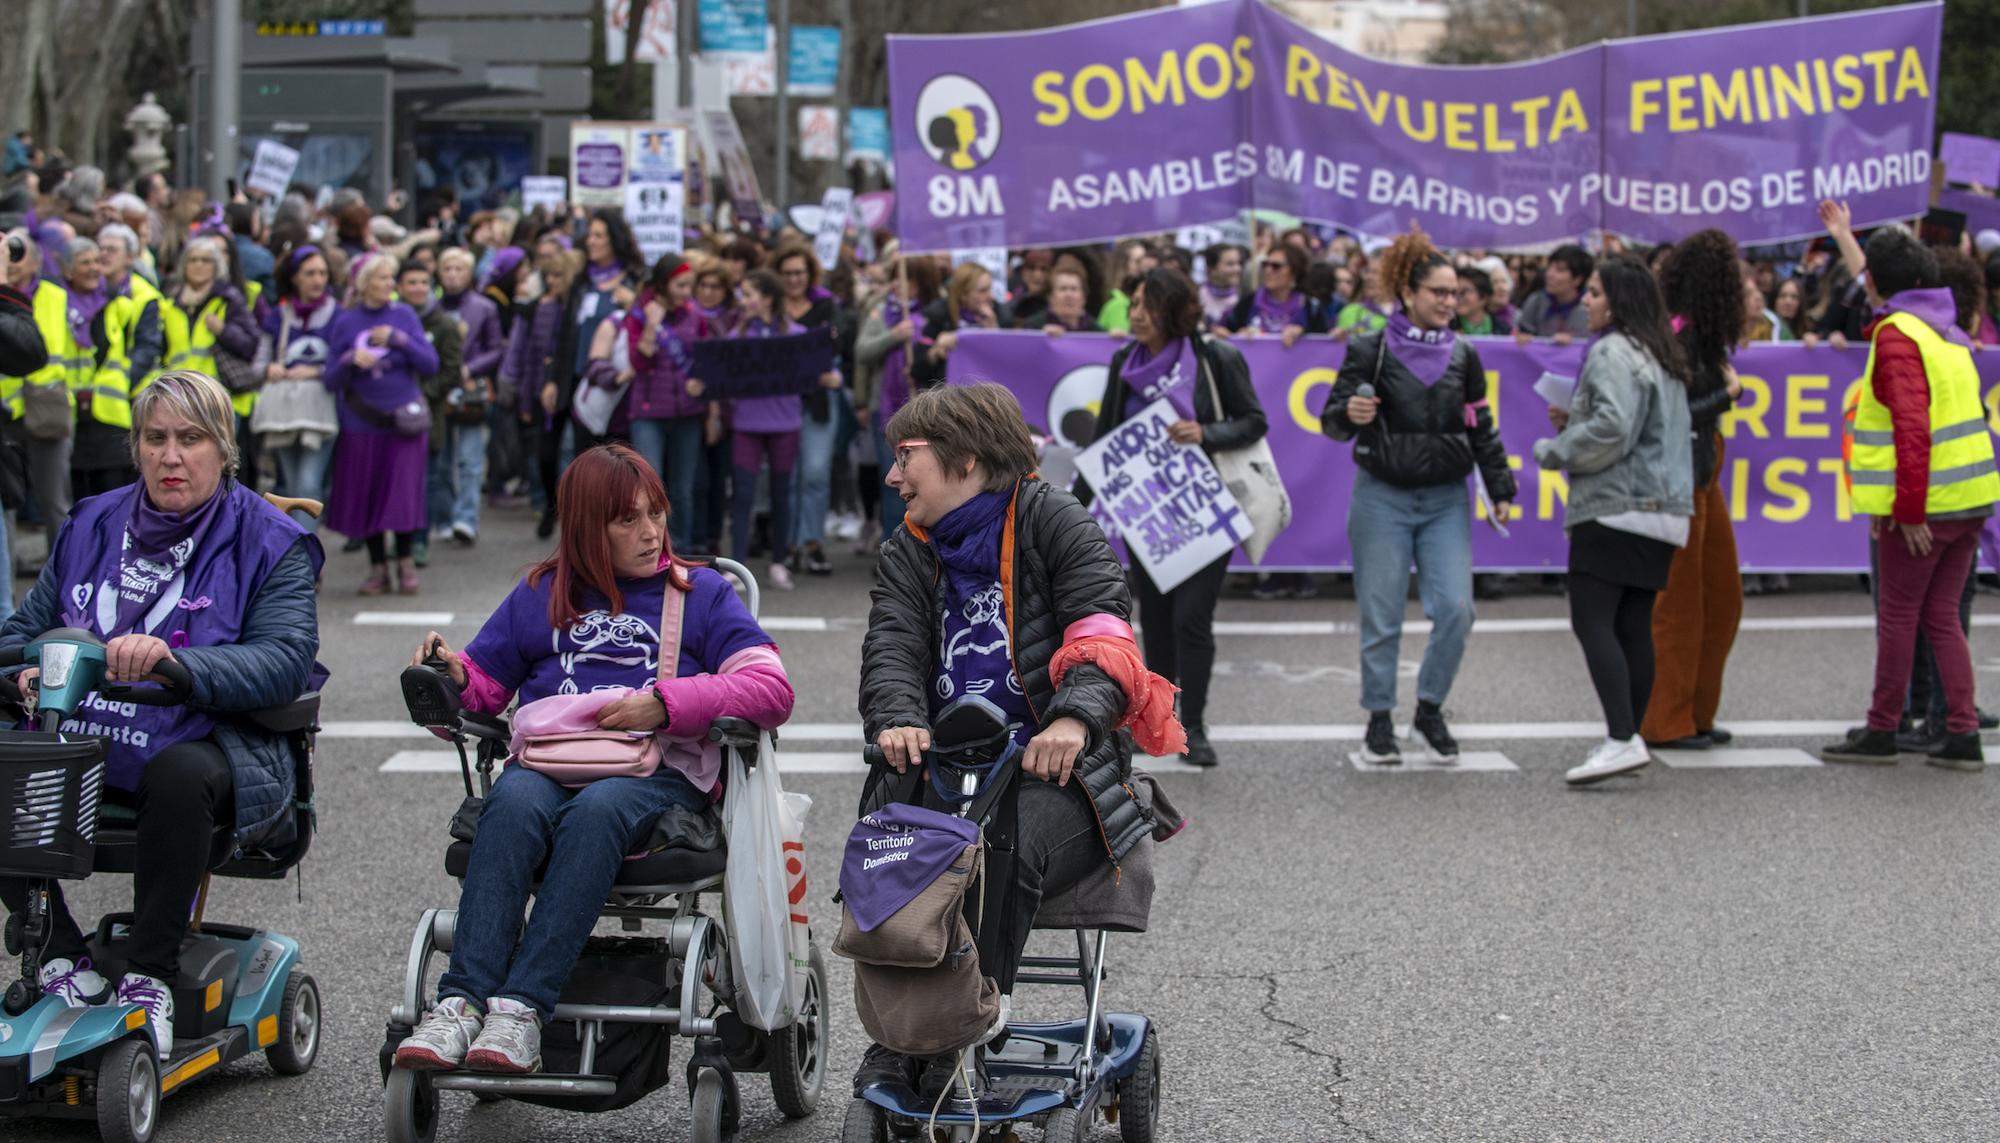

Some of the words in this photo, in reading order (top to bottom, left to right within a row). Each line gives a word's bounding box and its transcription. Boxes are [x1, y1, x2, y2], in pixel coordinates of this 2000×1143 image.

[1032, 36, 1255, 127] SOMOS
[1285, 45, 1589, 153] REVUELTA
[1629, 46, 1930, 133] FEMINISTA
[927, 175, 1005, 218] 8M
[1314, 155, 1361, 198] DE
[1368, 169, 1540, 226] BARRIOS
[1547, 184, 1571, 216] Y
[1579, 173, 1753, 215] PUEBLOS
[1760, 169, 1806, 208] DE
[1812, 149, 1931, 200] MADRID
[1100, 471, 1133, 502] MAS
[1144, 437, 1182, 467] QUE
[1102, 413, 1170, 477] AHORA
[1113, 449, 1208, 528] NUNCA
[1137, 470, 1224, 544] JUNTAS
[1148, 518, 1205, 566] SOMOS
[862, 851, 909, 871] Doméstica
[865, 833, 914, 851] Territorio
